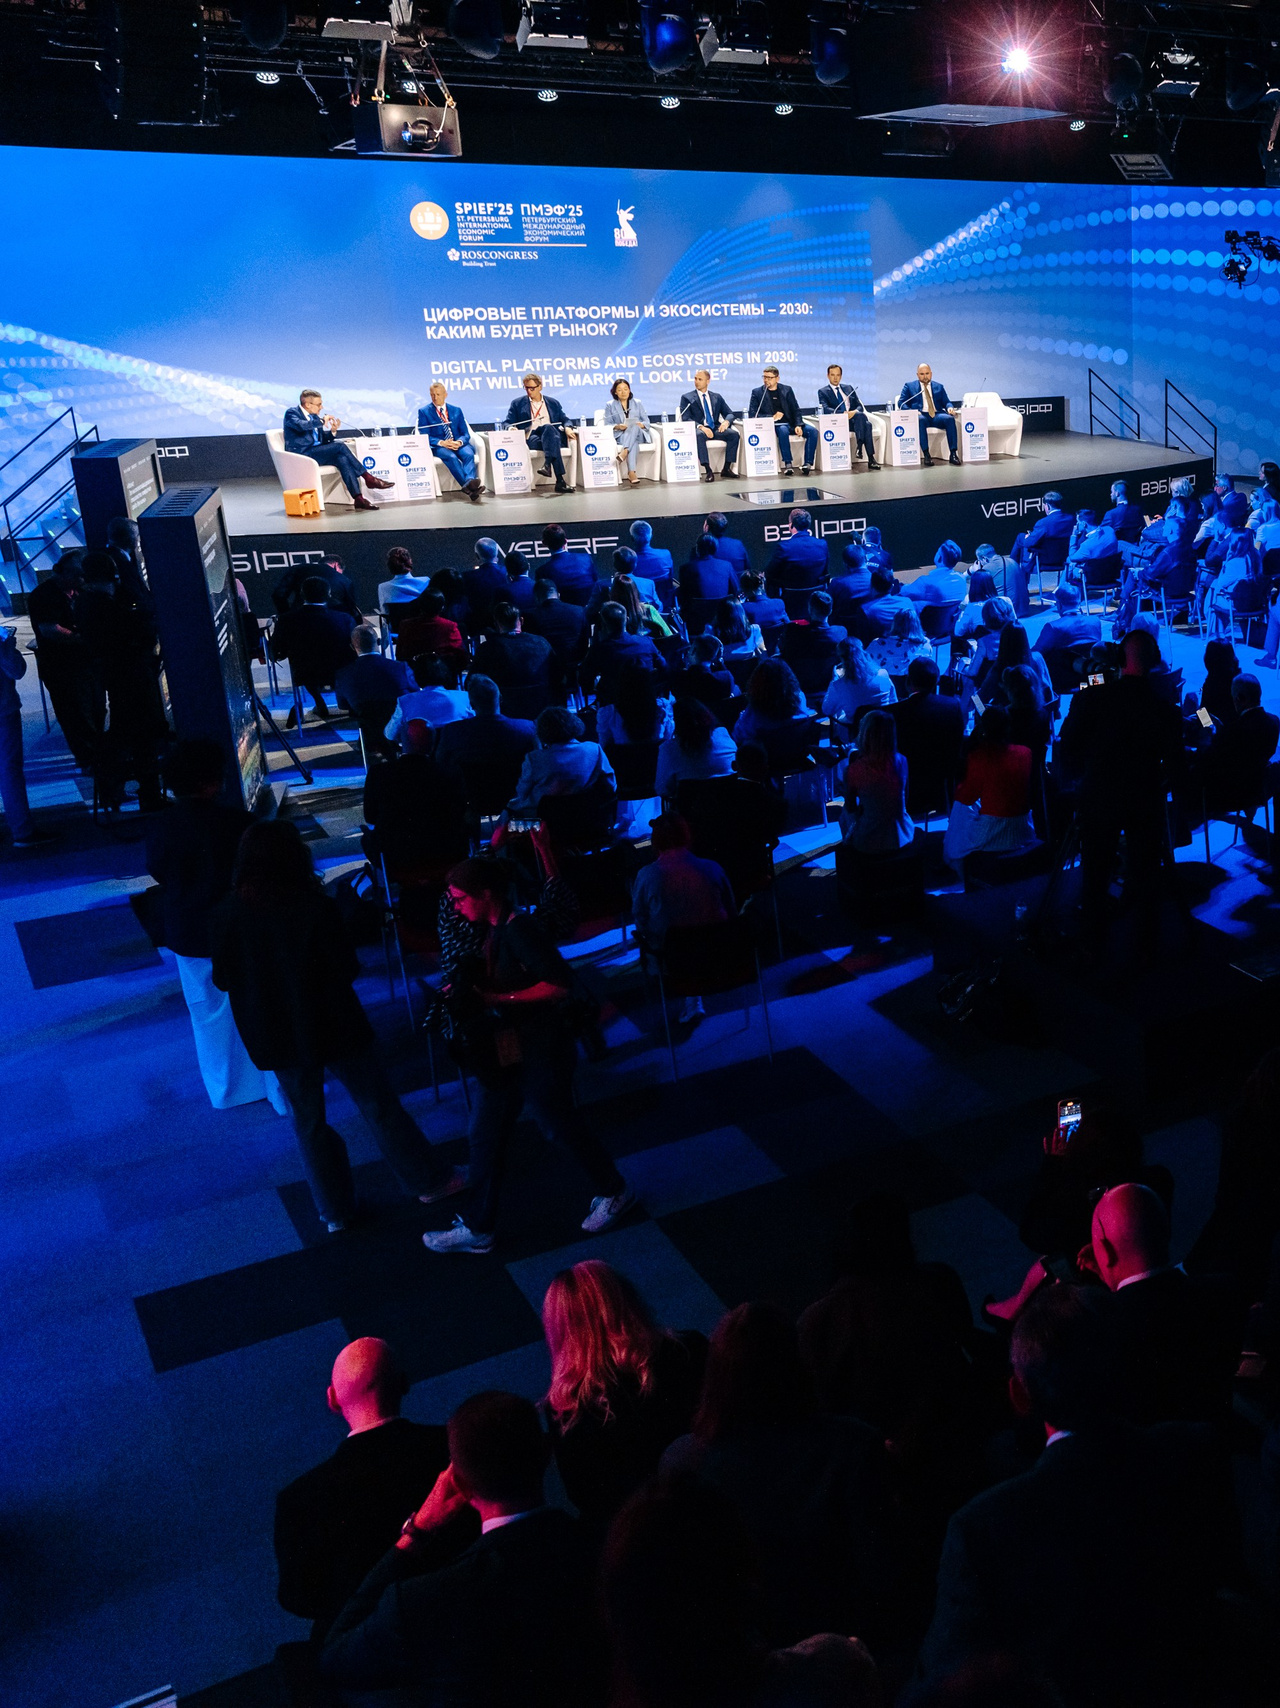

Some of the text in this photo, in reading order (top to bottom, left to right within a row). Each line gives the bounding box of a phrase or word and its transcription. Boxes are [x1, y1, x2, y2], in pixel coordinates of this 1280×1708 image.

[455, 202, 514, 215] SPIEF'25
[520, 203, 583, 216] ПМЭФ'25
[461, 250, 539, 260] ROSCONGRESS
[423, 307, 527, 324] ЦИФРОВЫЕ
[531, 305, 639, 320] ПЛАТФОРМЫ
[644, 305, 655, 318] И
[659, 303, 765, 318] ЭКОСИСТЕМЫ
[779, 302, 814, 315] 2030:
[425, 322, 618, 340] КАКИМ БУДЕТ РЫНОК?
[430, 350, 799, 375] DIGITAL PLATFORMS AND ECOSYSTEMS IN 2030:
[543, 373, 565, 388] HE
[568, 371, 635, 386] MARKET
[640, 370, 682, 384] LOOK
[687, 368, 728, 382] LE?
